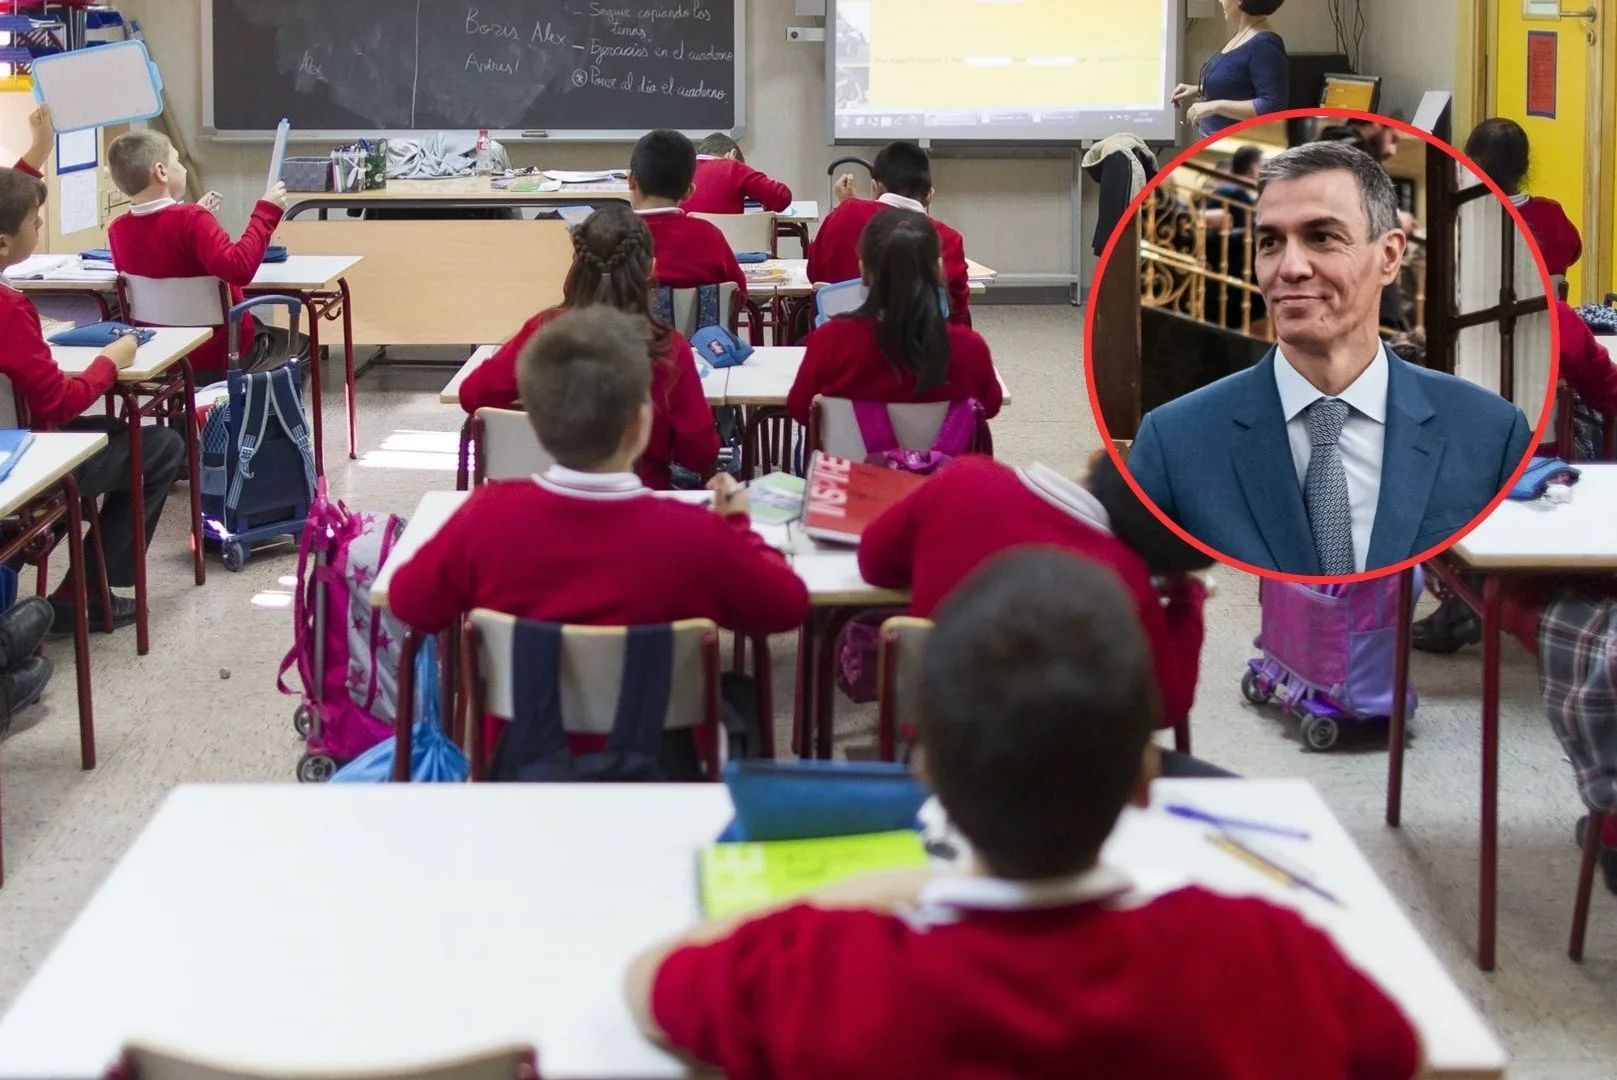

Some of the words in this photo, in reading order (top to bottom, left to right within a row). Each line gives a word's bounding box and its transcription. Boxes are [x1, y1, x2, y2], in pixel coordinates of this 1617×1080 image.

[638, 4, 689, 23] copiando
[465, 7, 519, 39] Boris
[531, 21, 566, 45] Alex
[654, 47, 668, 58] en
[673, 40, 684, 59] el
[621, 72, 633, 91] al
[661, 76, 673, 95] el
